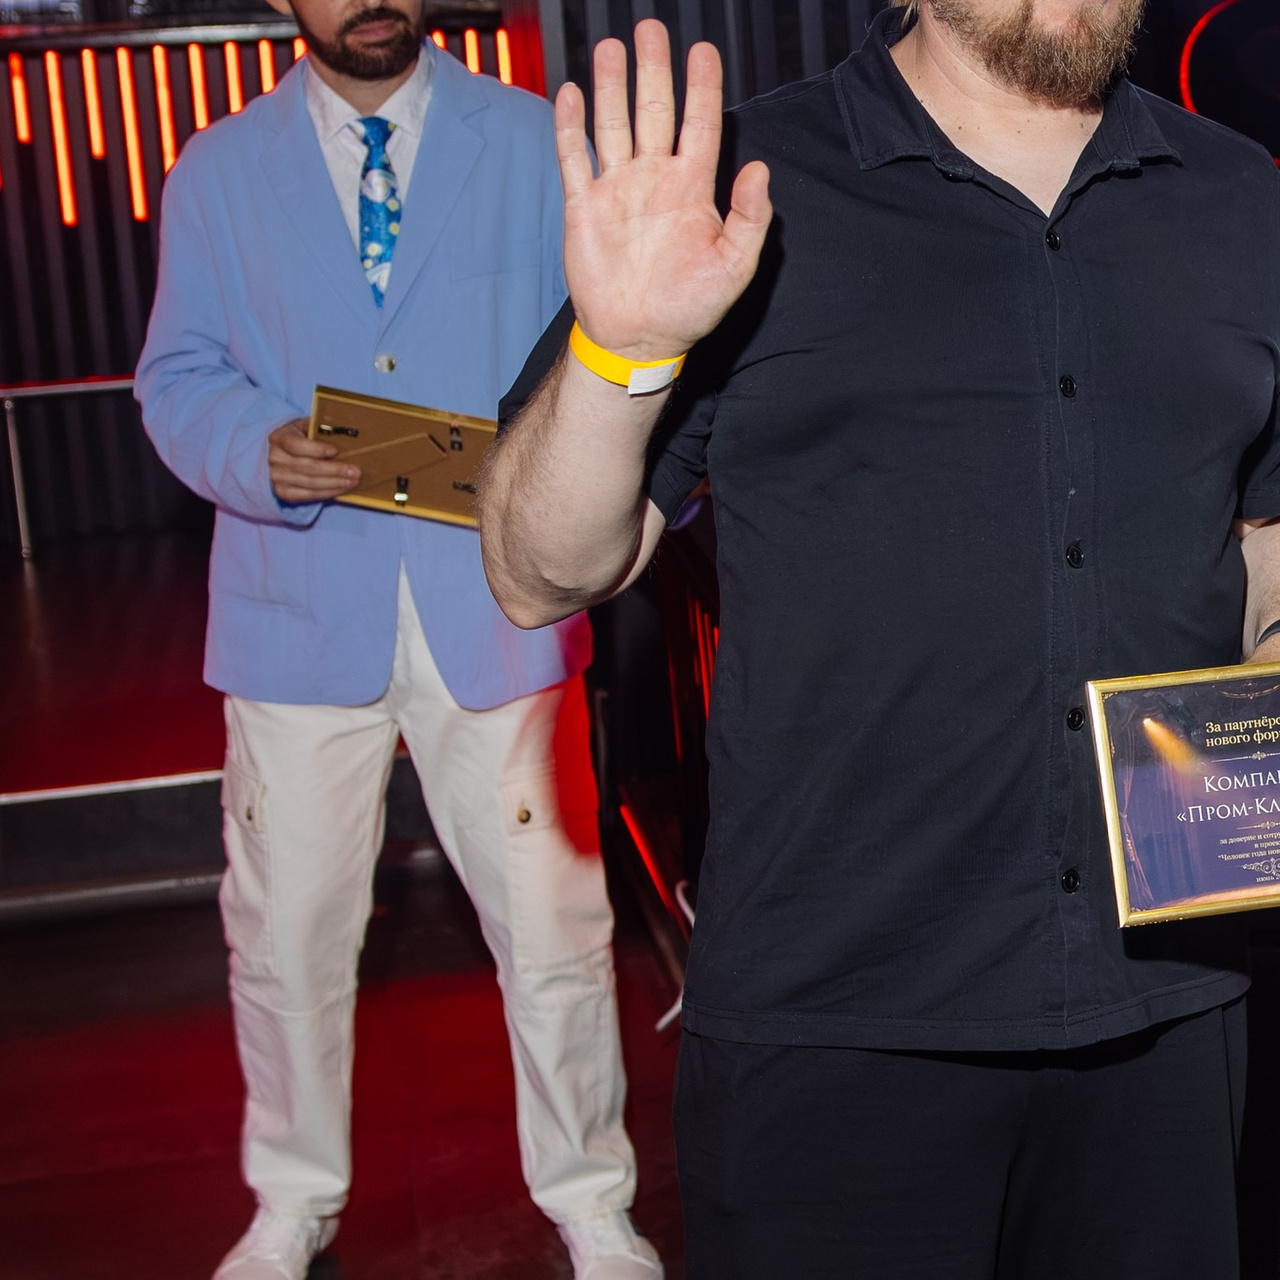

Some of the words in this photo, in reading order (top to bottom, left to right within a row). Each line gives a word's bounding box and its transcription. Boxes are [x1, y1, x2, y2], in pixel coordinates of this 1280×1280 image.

[1205, 721, 1221, 734] За
[1205, 733, 1251, 748] нового
[1251, 849, 1267, 857] года
